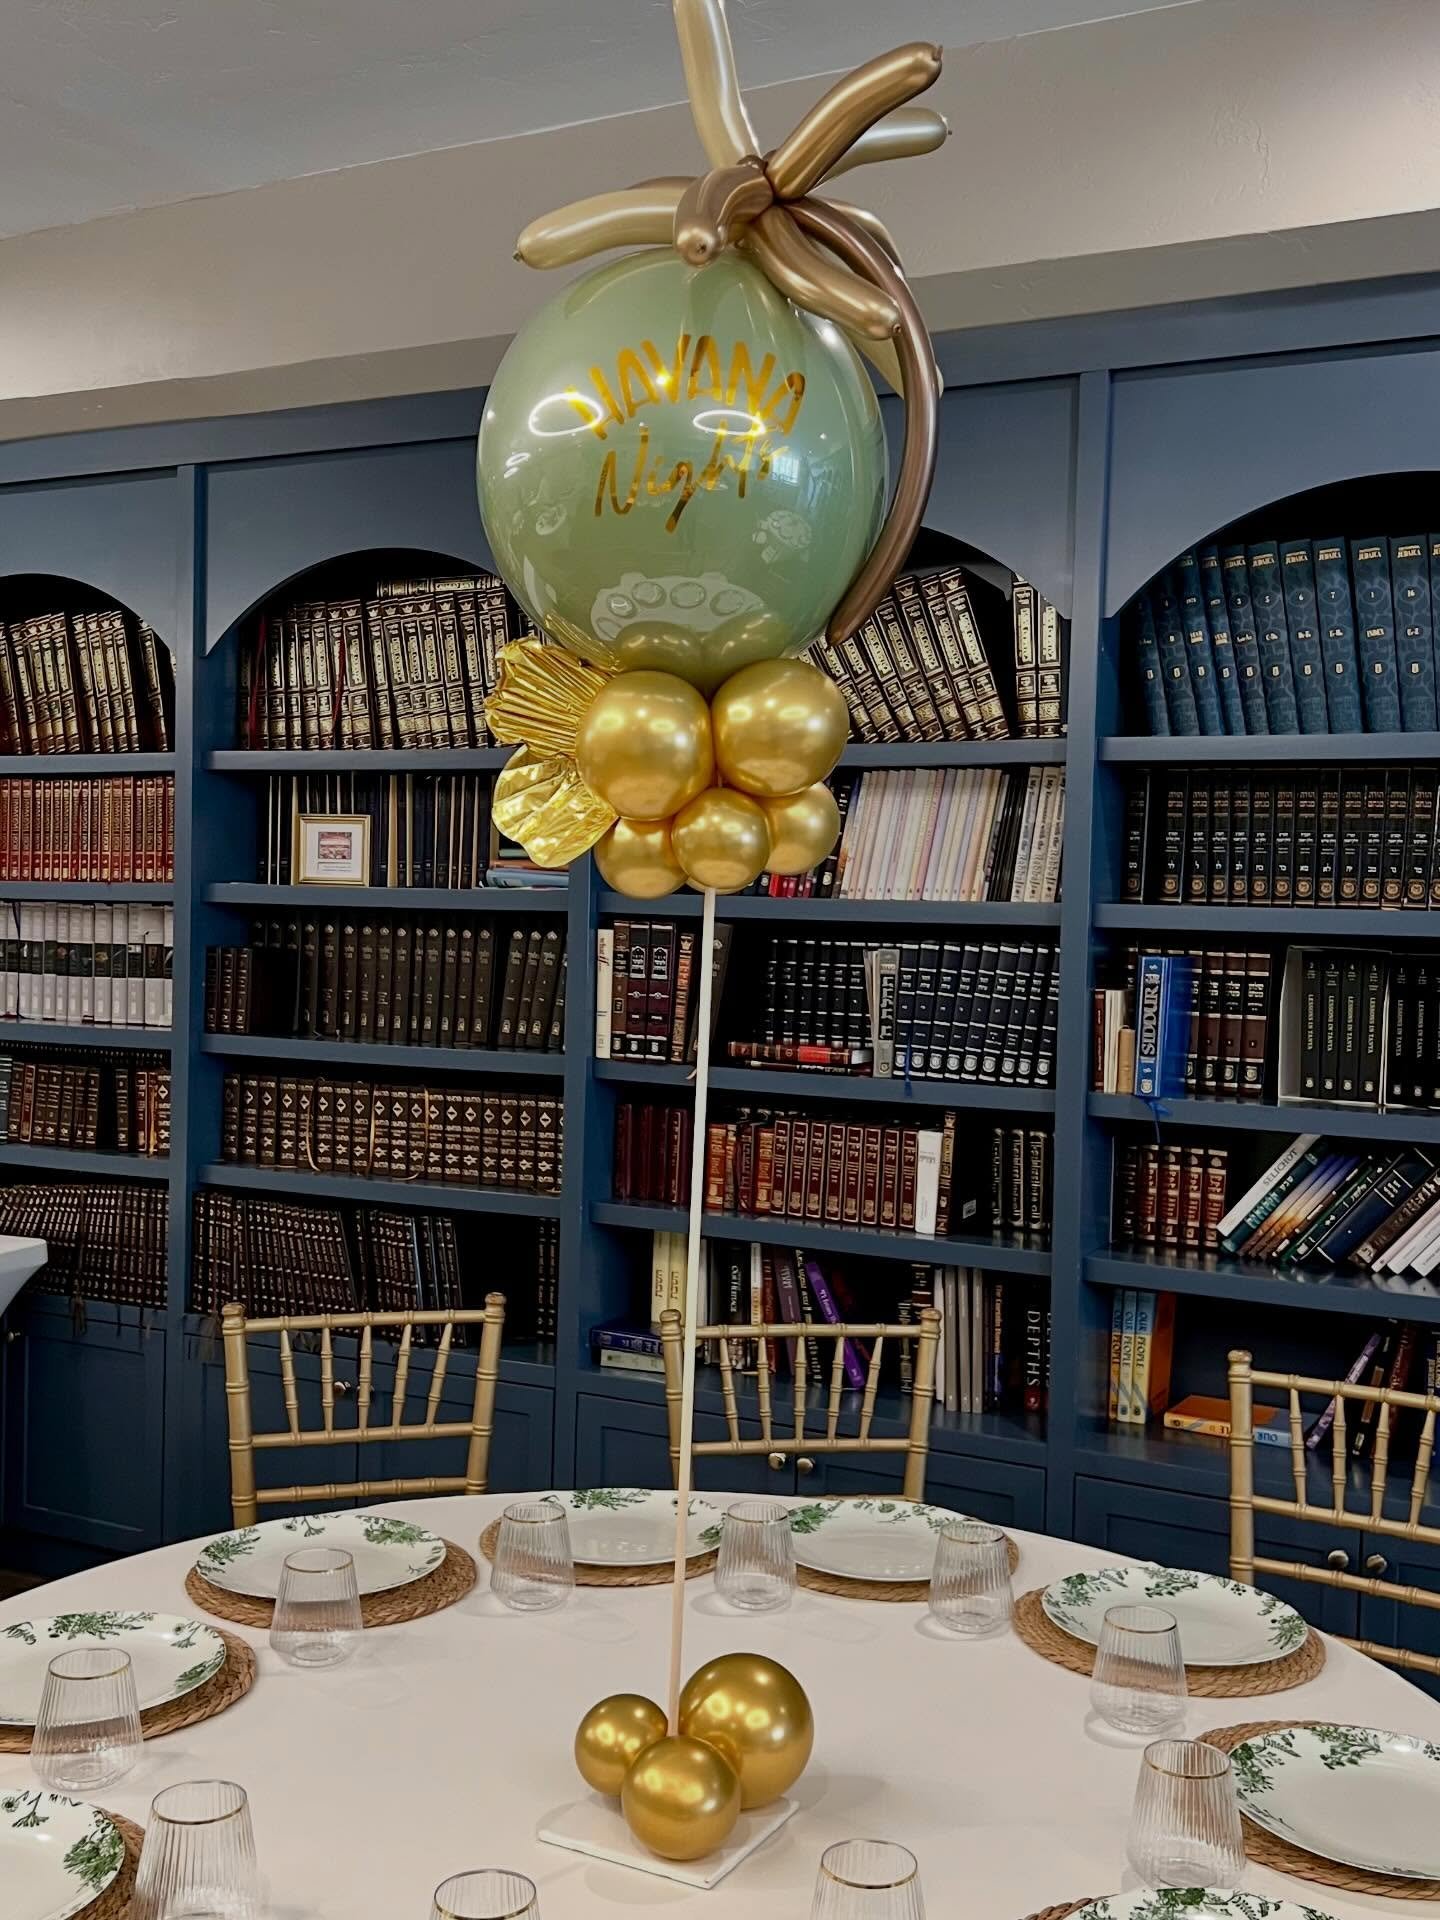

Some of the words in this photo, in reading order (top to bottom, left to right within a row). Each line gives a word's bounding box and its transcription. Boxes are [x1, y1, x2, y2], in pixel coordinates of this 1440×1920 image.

[1141, 986, 1159, 1056] SIDDUR
[1263, 1147, 1298, 1187] SELICHOT
[730, 1281, 738, 1312] HERITAGE
[1125, 1312, 1134, 1330] OUR
[1137, 1312, 1147, 1331] OUR
[1026, 1310, 1040, 1387] DEPTHS
[1122, 1336, 1132, 1367] PEOPLE
[1136, 1337, 1146, 1368] PEOPLE
[1257, 1432, 1278, 1442] OUR
